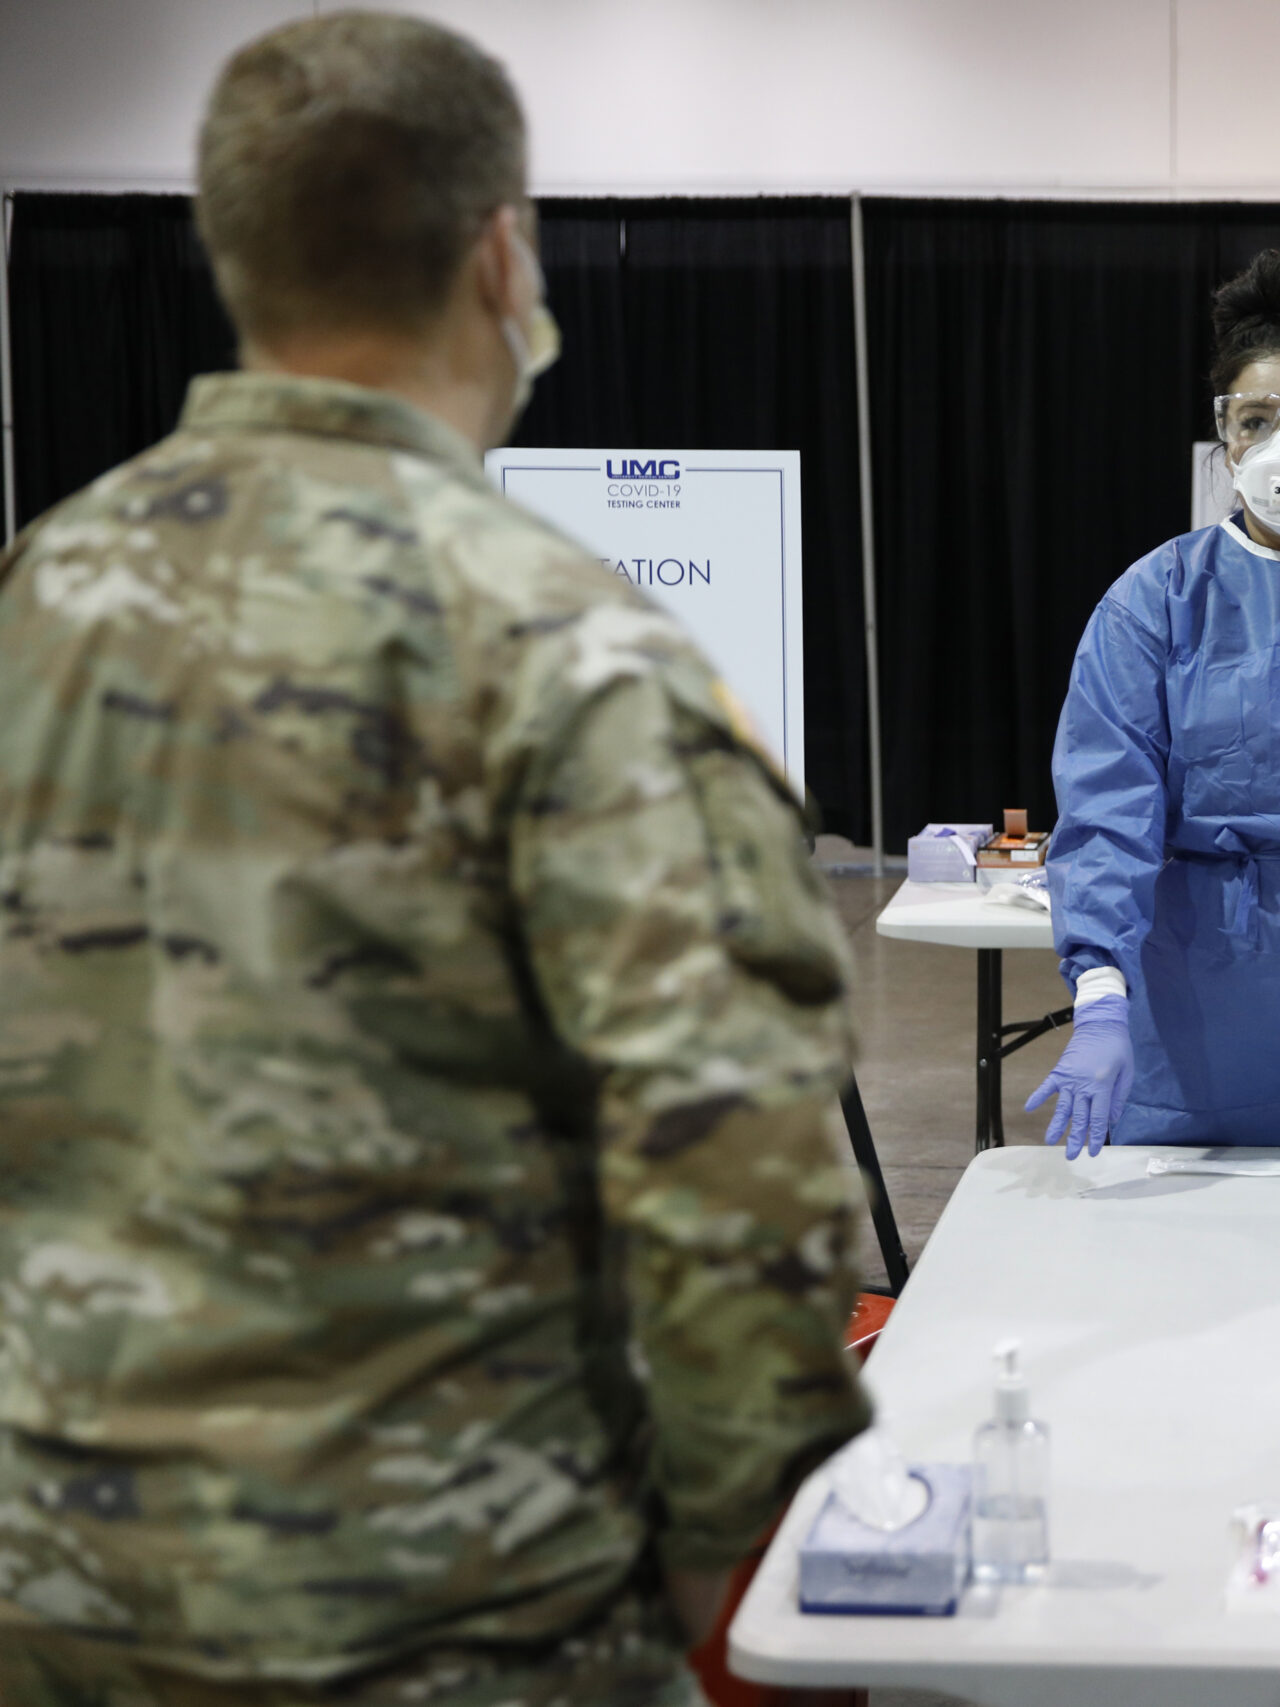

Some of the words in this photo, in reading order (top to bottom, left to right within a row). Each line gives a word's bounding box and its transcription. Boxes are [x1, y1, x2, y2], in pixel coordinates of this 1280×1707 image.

[606, 459, 680, 479] UMC
[607, 484, 681, 496] COVID-19
[607, 500, 643, 508] TESTING
[646, 500, 681, 508] CENTER
